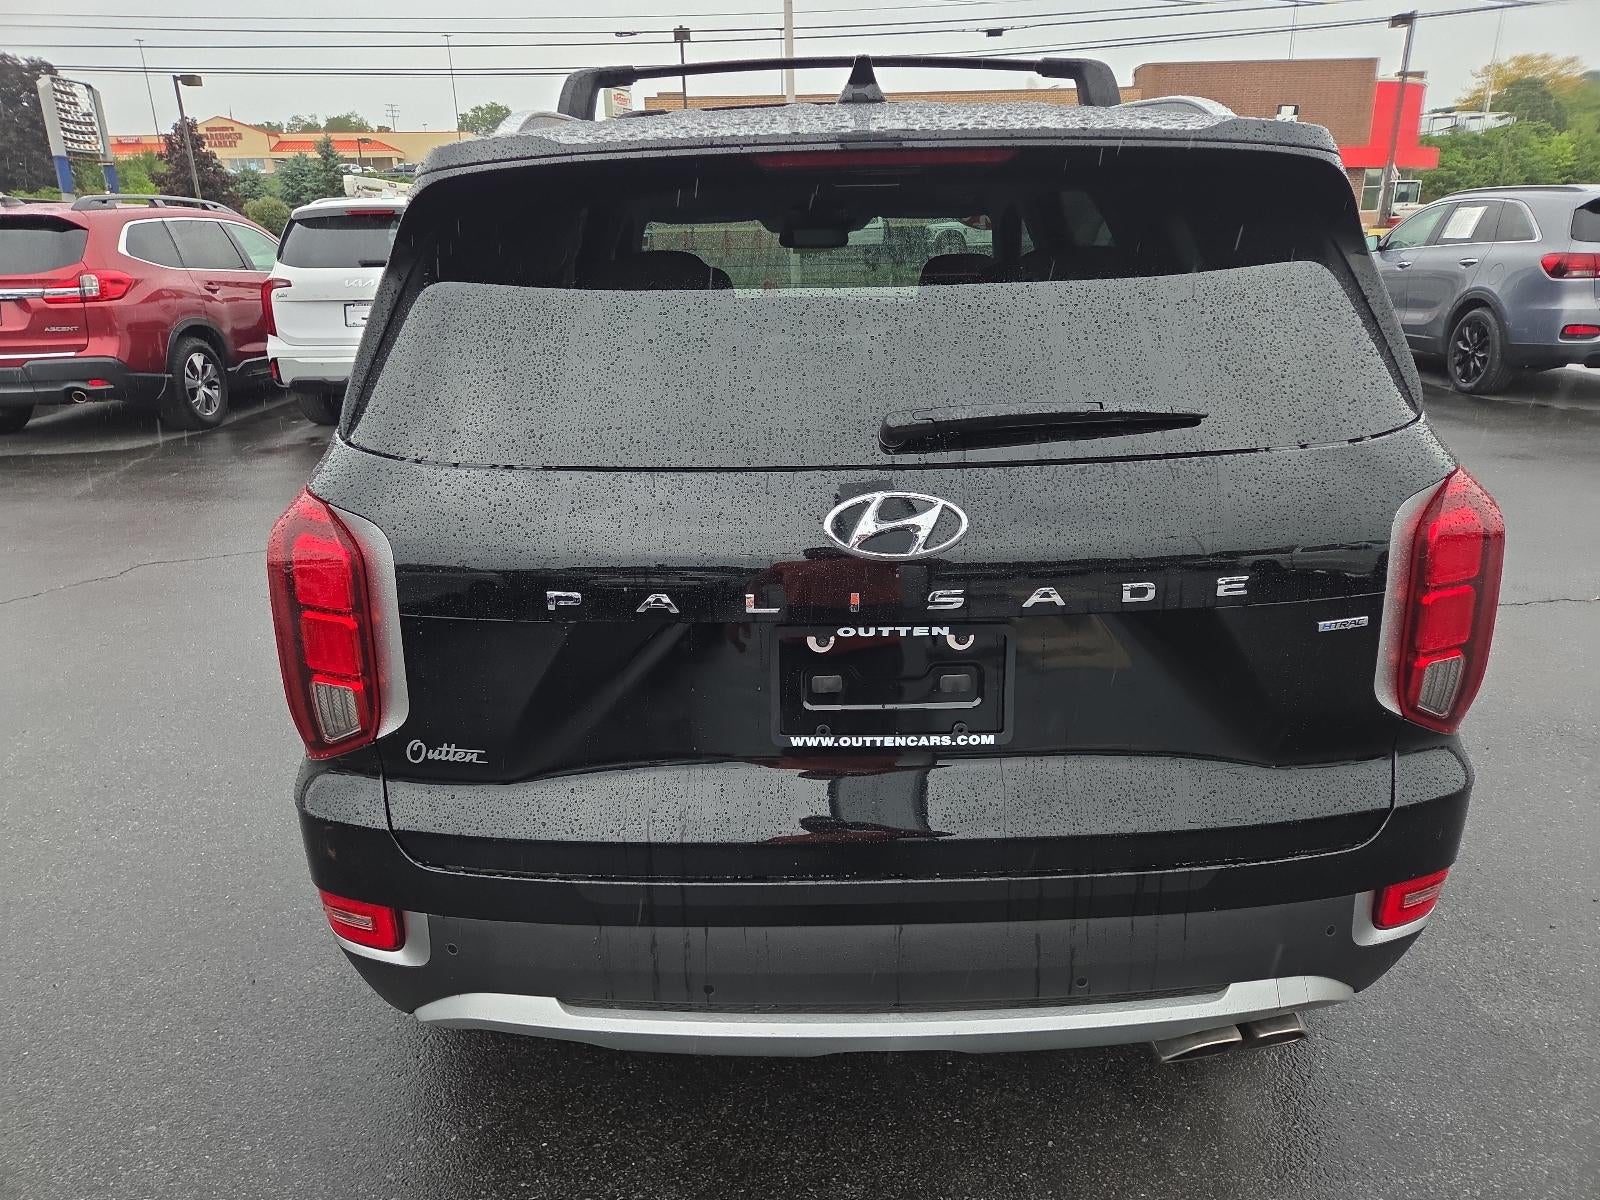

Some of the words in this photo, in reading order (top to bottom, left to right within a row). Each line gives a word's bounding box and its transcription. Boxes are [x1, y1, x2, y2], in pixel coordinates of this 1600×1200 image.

[546, 575, 1250, 613] PALISADE
[1320, 617, 1367, 631] HTRAC
[836, 626, 950, 637] OUTTEN
[790, 735, 995, 747] WWW.OUTTENCARS.COM
[406, 739, 489, 764] Outten
